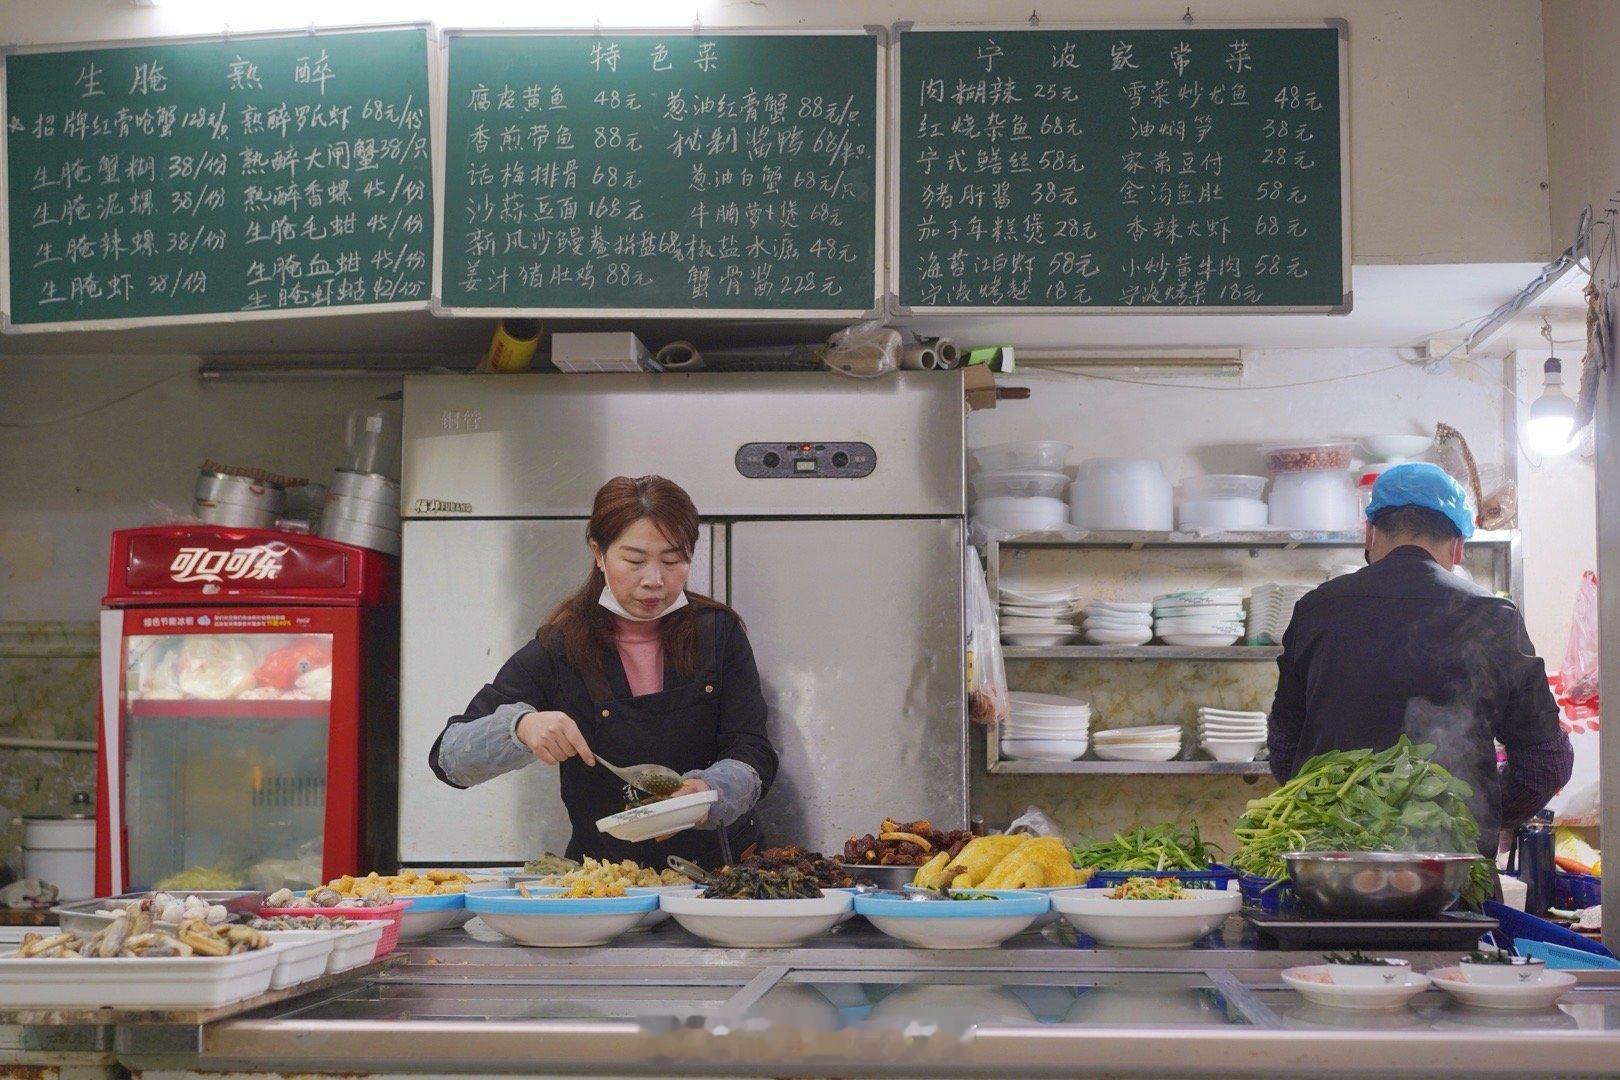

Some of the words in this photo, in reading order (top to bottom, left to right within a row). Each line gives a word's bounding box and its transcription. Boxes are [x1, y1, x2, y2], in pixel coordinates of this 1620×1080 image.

[590, 42, 717, 72] 特色菜
[976, 38, 1252, 77] 宁波家常菜
[75, 59, 168, 98] 生腌
[227, 48, 335, 95] 熟醉
[468, 84, 567, 112] 腐皮黄鱼
[594, 90, 642, 111] 48元
[663, 87, 788, 125] 葱油红膏蟹
[798, 95, 861, 127] 88元/只
[1033, 84, 1079, 101] 25元
[1274, 85, 1322, 111] 48元
[241, 102, 352, 138] 熟醉罗氏虾
[362, 95, 423, 129] 68元/份
[917, 111, 1032, 142] 红烧杂鱼
[1040, 113, 1083, 136] 68元
[1262, 119, 1314, 142] 38元
[470, 124, 574, 153] 香煎带鱼
[594, 127, 643, 151] 88元
[667, 125, 804, 161] 秘制酱鸭
[33, 153, 155, 189] 生腌蟹糊
[169, 151, 228, 180] 38/份
[239, 137, 378, 177] 熟醉大闸蟹
[379, 132, 428, 165] 38/只
[916, 146, 1032, 175] 宁式鳝丝
[1038, 149, 1085, 172] 58元
[1121, 150, 1224, 176] 家常豆付
[1261, 147, 1315, 169] 28元
[467, 159, 578, 188] 话梅排骨
[592, 165, 642, 189] 68元
[688, 162, 782, 195] 葱油白蟹
[793, 170, 856, 199] 68元/只
[33, 188, 158, 228] 生腌泥螺
[171, 184, 225, 216] 38/份
[244, 177, 352, 212] 熟醉香螺
[363, 174, 425, 205] 45/份
[466, 193, 578, 224] 沙蒜豆面
[588, 196, 644, 221] 168元
[922, 181, 1011, 209] 猪肝酱
[1030, 181, 1078, 205] 38元
[1120, 180, 1224, 206] 金汤鱼肚
[1256, 180, 1307, 204] 58元
[245, 212, 357, 245] 生腌毛蚶
[367, 209, 424, 239] 45/份
[810, 202, 843, 227] 68元
[917, 213, 1046, 245] 茄子年糕煲
[1053, 218, 1097, 240] 28元
[1126, 214, 1232, 245] 香辣大虾
[1255, 215, 1307, 237] 68元
[33, 228, 158, 268] 生腌辣螺
[168, 225, 226, 255] 38/份
[809, 237, 857, 263] 48元
[247, 250, 361, 286] 生腌血蚶
[371, 244, 426, 273] 45/份
[459, 259, 595, 293] 姜汁猪肚鸡
[606, 263, 653, 287] 88元
[1048, 251, 1100, 278] 58元
[1122, 252, 1241, 282] 小炒黄牛肉
[1255, 254, 1308, 278] 58元
[38, 272, 134, 305] 生腌虾
[373, 273, 425, 301] 42/份
[780, 271, 843, 296] 228元
[1046, 280, 1092, 304] 18元
[1219, 283, 1264, 303] 18元
[170, 541, 290, 582] 可口可乐
